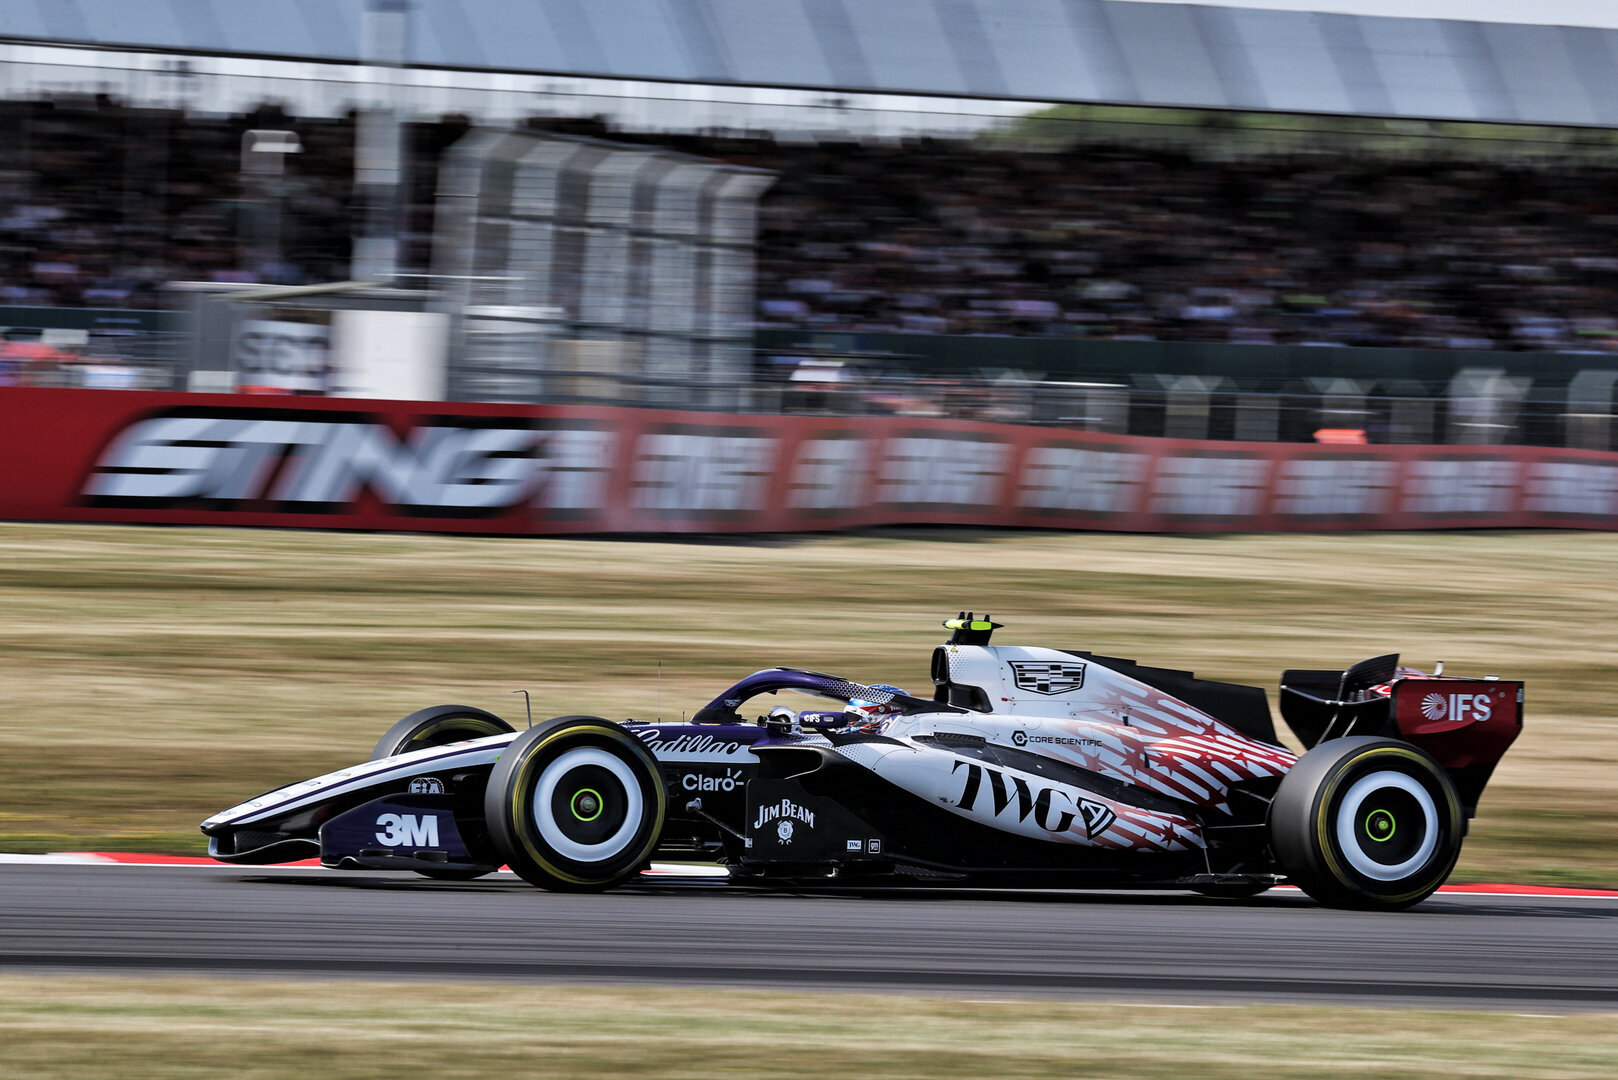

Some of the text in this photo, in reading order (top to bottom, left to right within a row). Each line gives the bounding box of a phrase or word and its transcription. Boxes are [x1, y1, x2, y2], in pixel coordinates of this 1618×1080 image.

[809, 714, 820, 723] IFS
[1448, 694, 1492, 722] IFS
[1029, 736, 1103, 747] CORE SCIENTIFIC
[682, 771, 739, 791] Claro
[951, 760, 1077, 833] TWG
[754, 798, 815, 829] JIM BEAM
[375, 813, 440, 847] 3M
